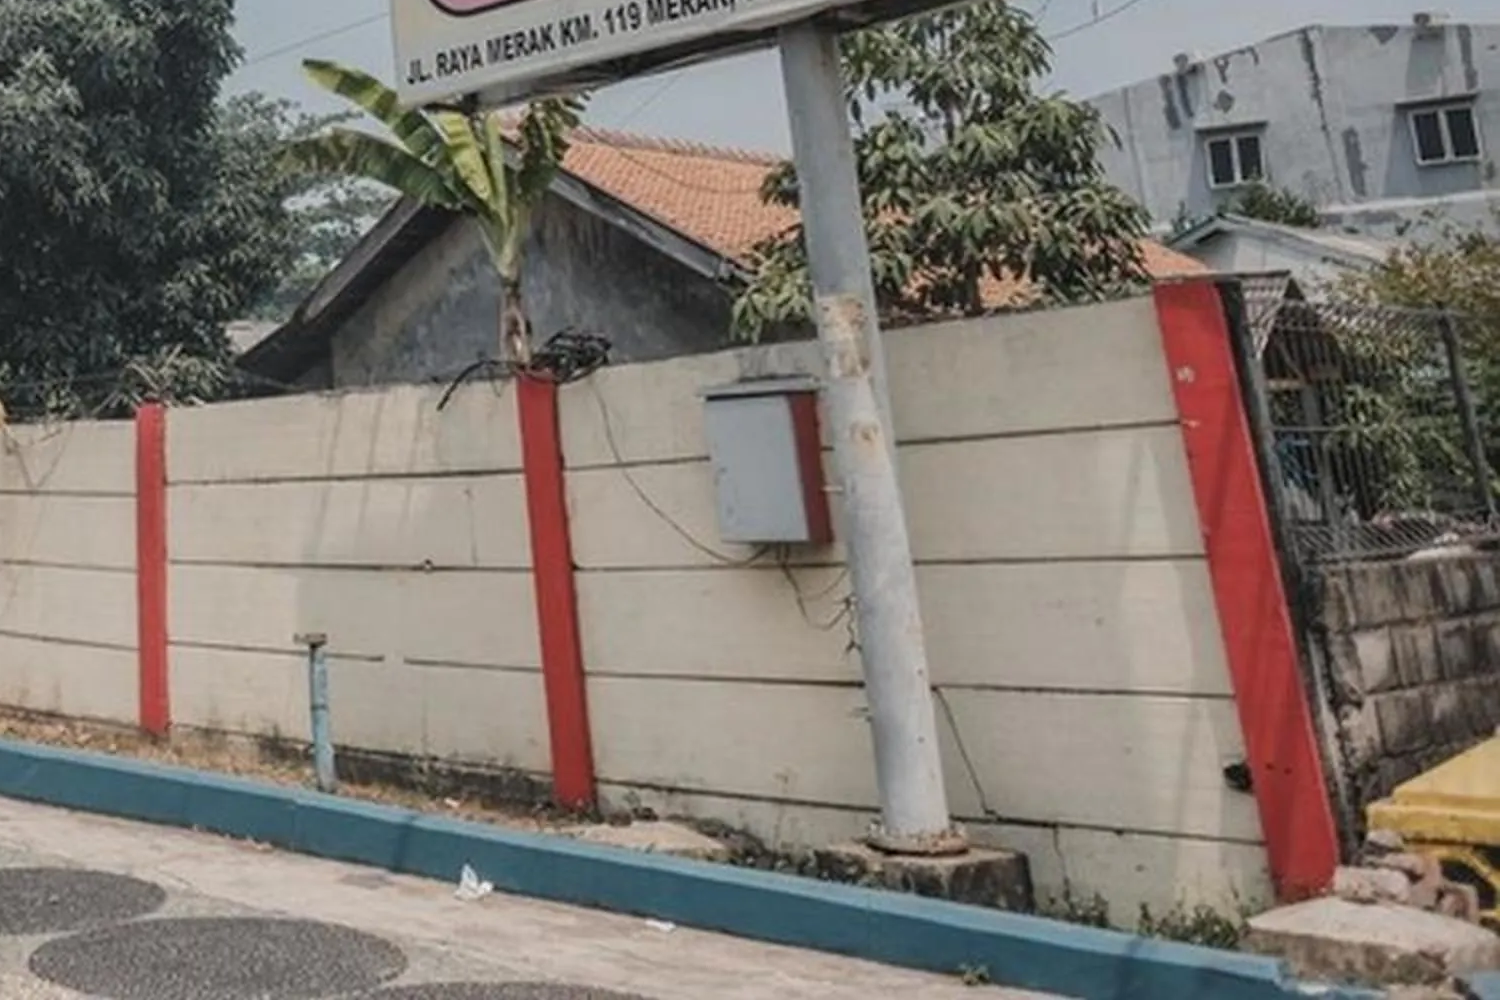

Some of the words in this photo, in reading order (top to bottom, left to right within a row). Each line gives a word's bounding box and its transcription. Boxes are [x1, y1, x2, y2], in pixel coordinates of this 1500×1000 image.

[406, 58, 432, 87] JL.
[435, 42, 485, 80] RAYA
[485, 24, 559, 63] MERAK
[559, 14, 599, 48] KM.
[603, 1, 643, 36] 119
